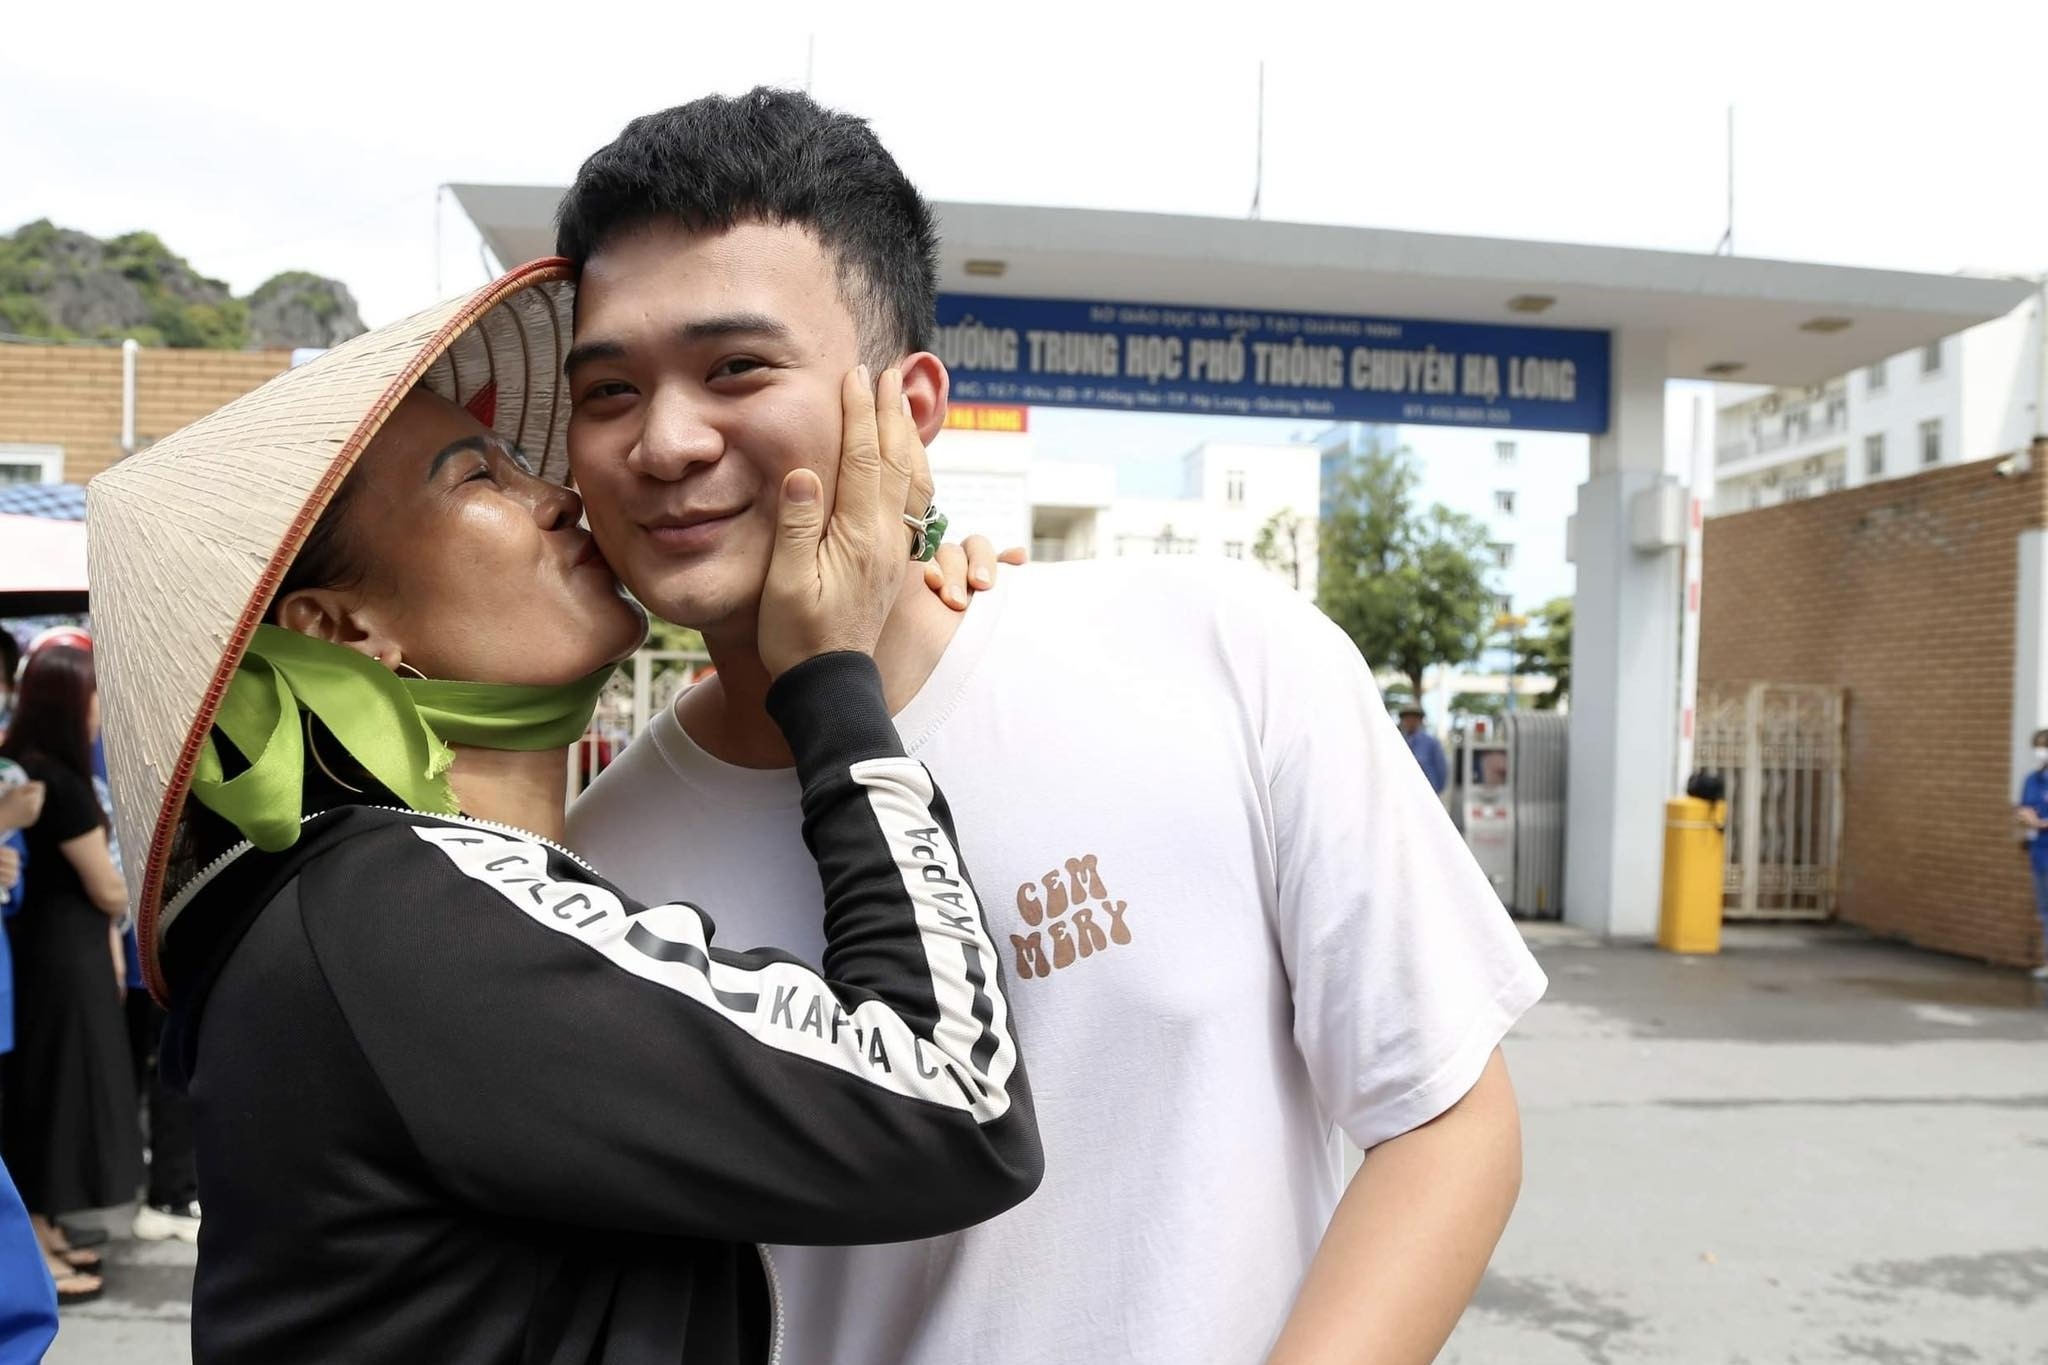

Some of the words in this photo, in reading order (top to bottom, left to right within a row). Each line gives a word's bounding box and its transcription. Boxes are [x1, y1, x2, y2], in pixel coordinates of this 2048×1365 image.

[1027, 329, 1119, 376] TRUNG
[1125, 335, 1183, 385] HỌC
[1254, 337, 1344, 389] THÔNG
[1351, 345, 1456, 394] CHUYÊN
[1462, 354, 1500, 404] HẠ
[1509, 356, 1576, 401] LONG
[904, 827, 976, 936] KAPPA
[1009, 900, 1132, 980] MERY
[770, 985, 892, 1073] KAPA
